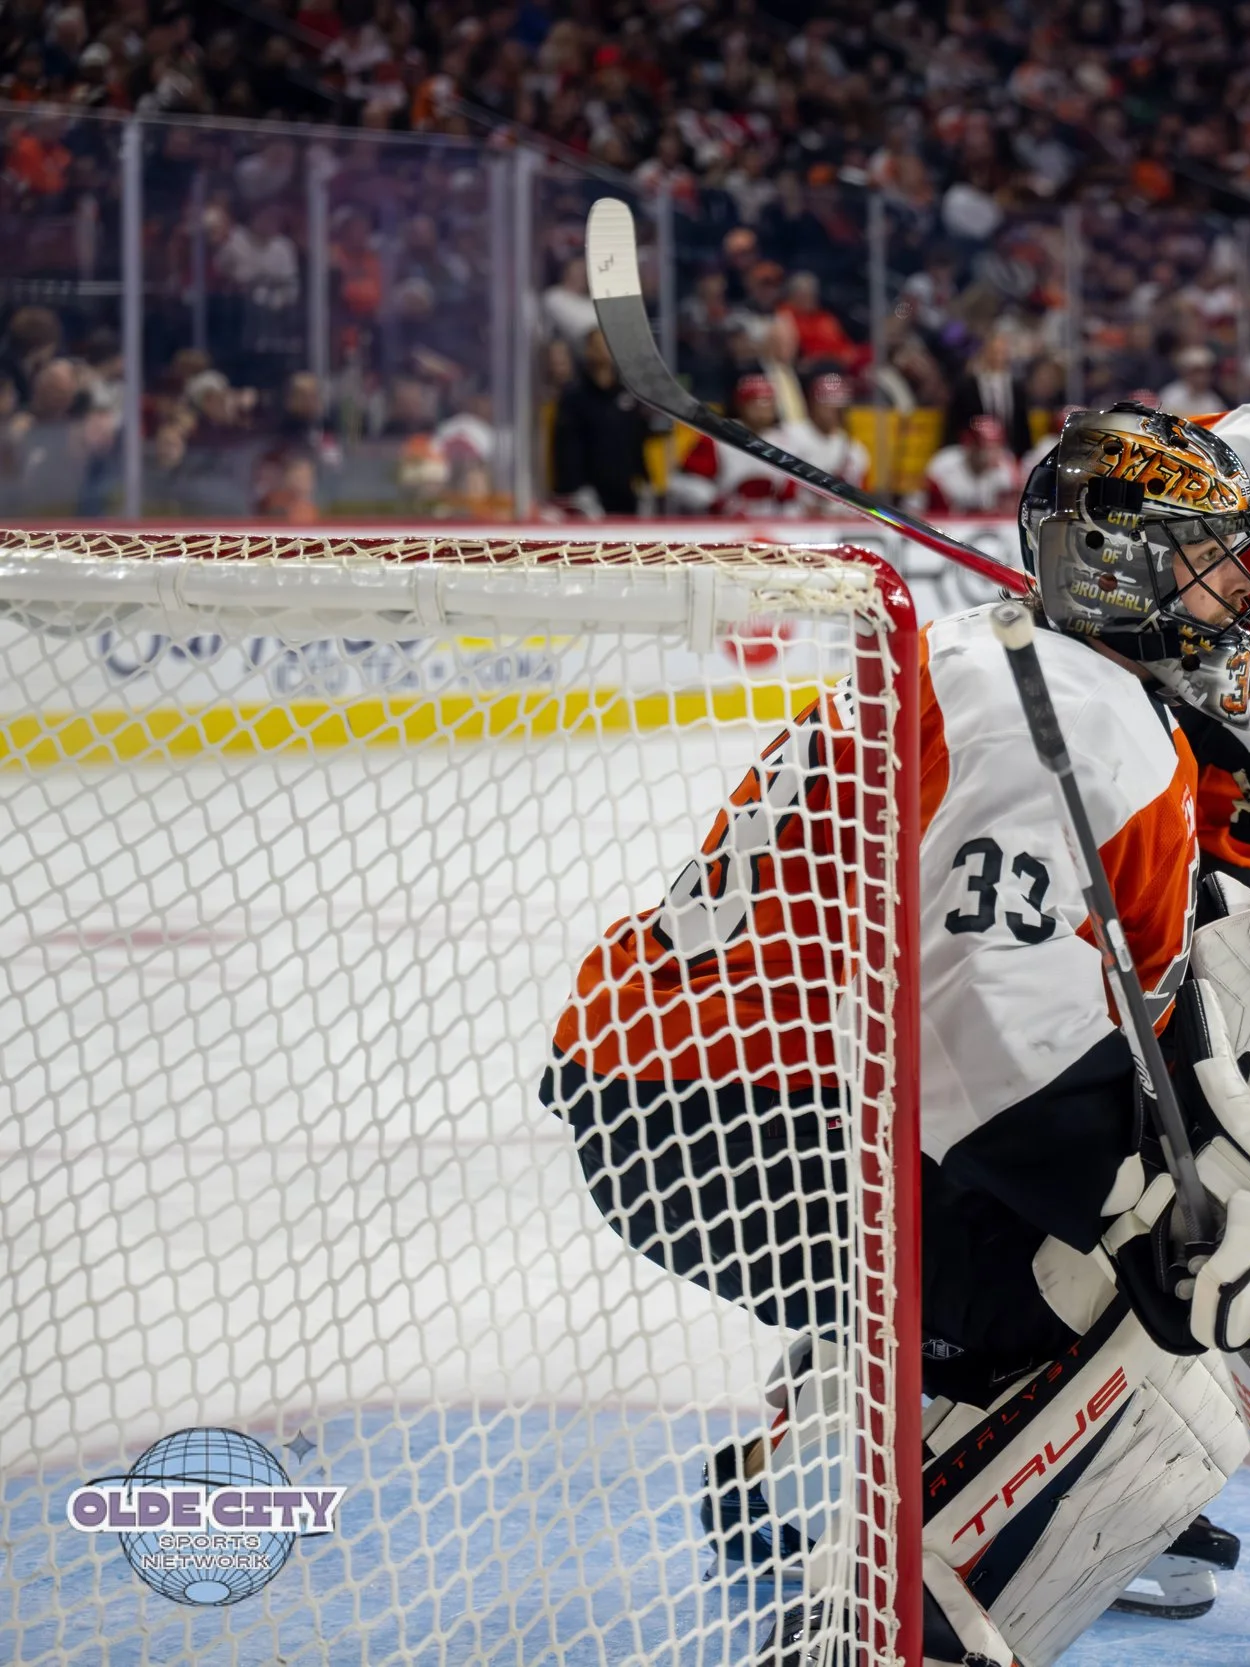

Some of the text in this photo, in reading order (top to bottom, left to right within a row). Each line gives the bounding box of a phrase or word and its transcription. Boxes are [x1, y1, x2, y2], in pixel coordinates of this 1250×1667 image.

[1107, 511, 1141, 528] CITY
[1102, 548, 1119, 564] OF
[1070, 580, 1154, 613] BROTHERLY
[1067, 617, 1103, 636] LOVE
[944, 837, 1056, 945] 33
[928, 1338, 1083, 1497] ATALYST
[951, 1366, 1128, 1544] TRUE
